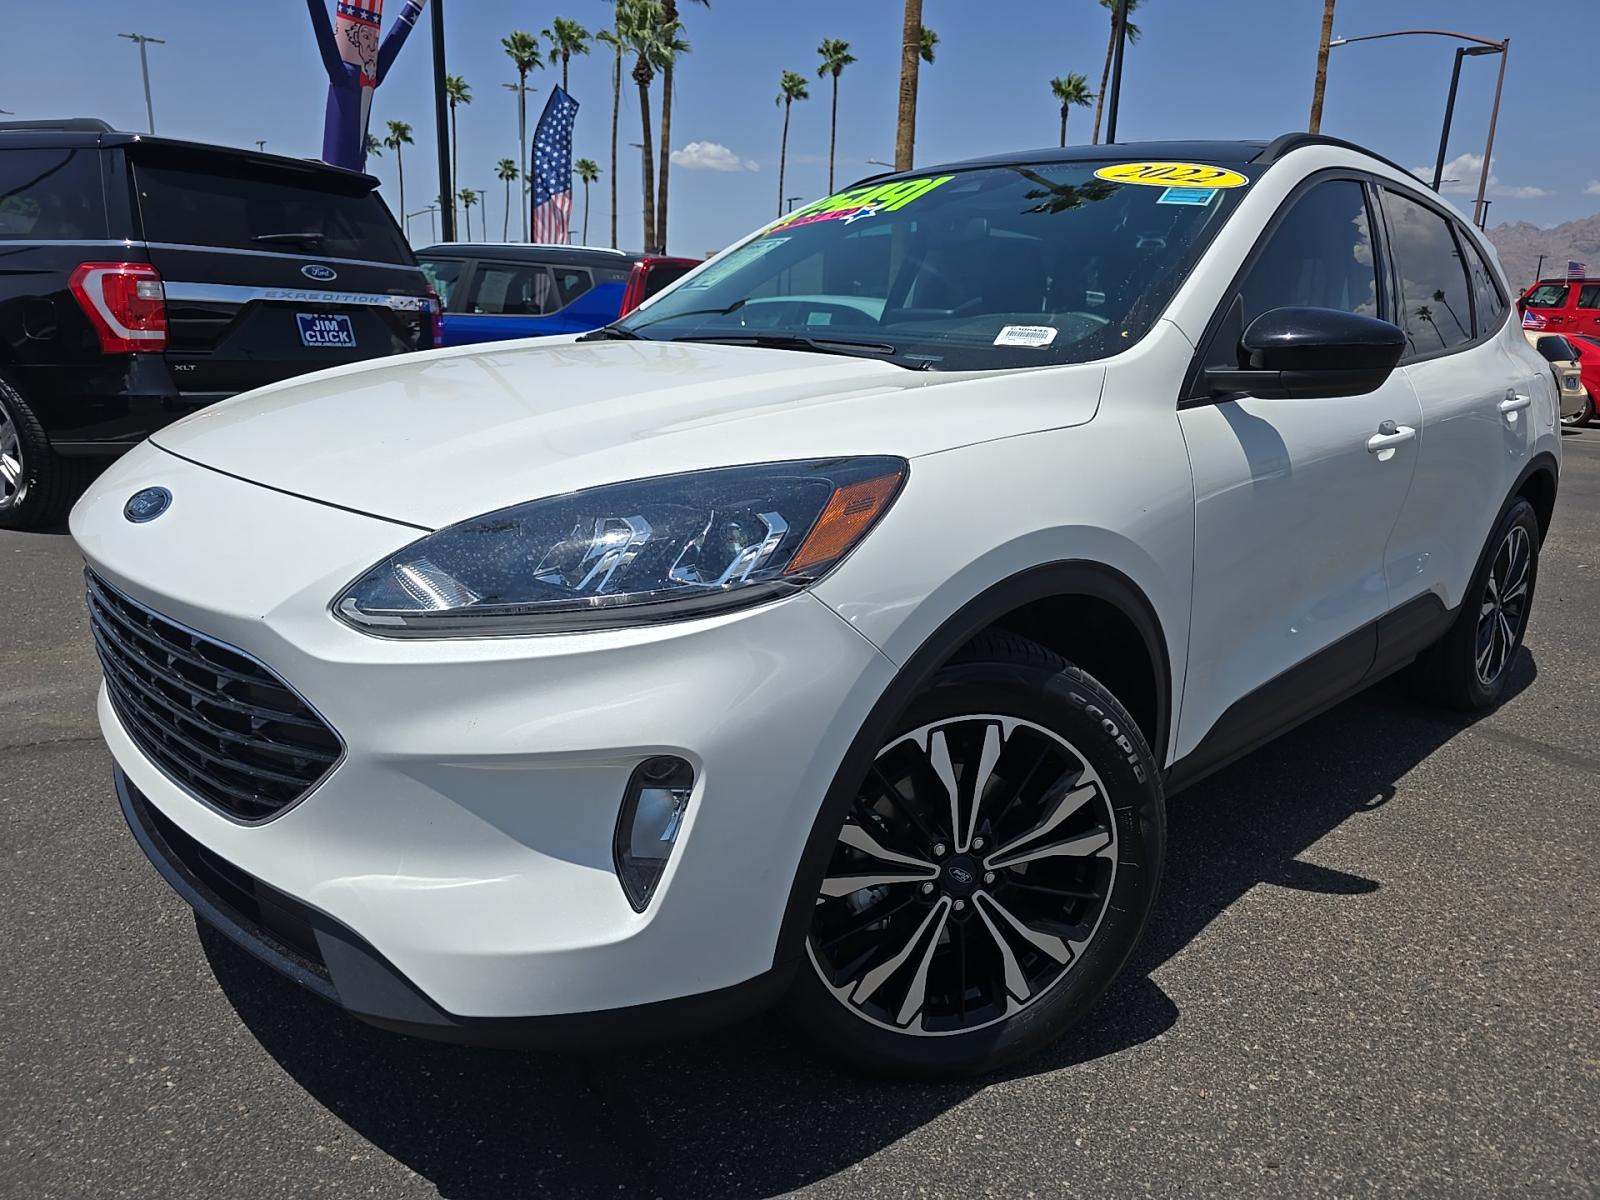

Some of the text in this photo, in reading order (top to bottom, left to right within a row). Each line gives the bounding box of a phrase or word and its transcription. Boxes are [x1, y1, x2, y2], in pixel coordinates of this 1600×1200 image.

[1113, 165, 1226, 183] 2022
[264, 291, 379, 304] EXPEDITION
[313, 319, 339, 331] JIM
[305, 330, 350, 342] CLICK
